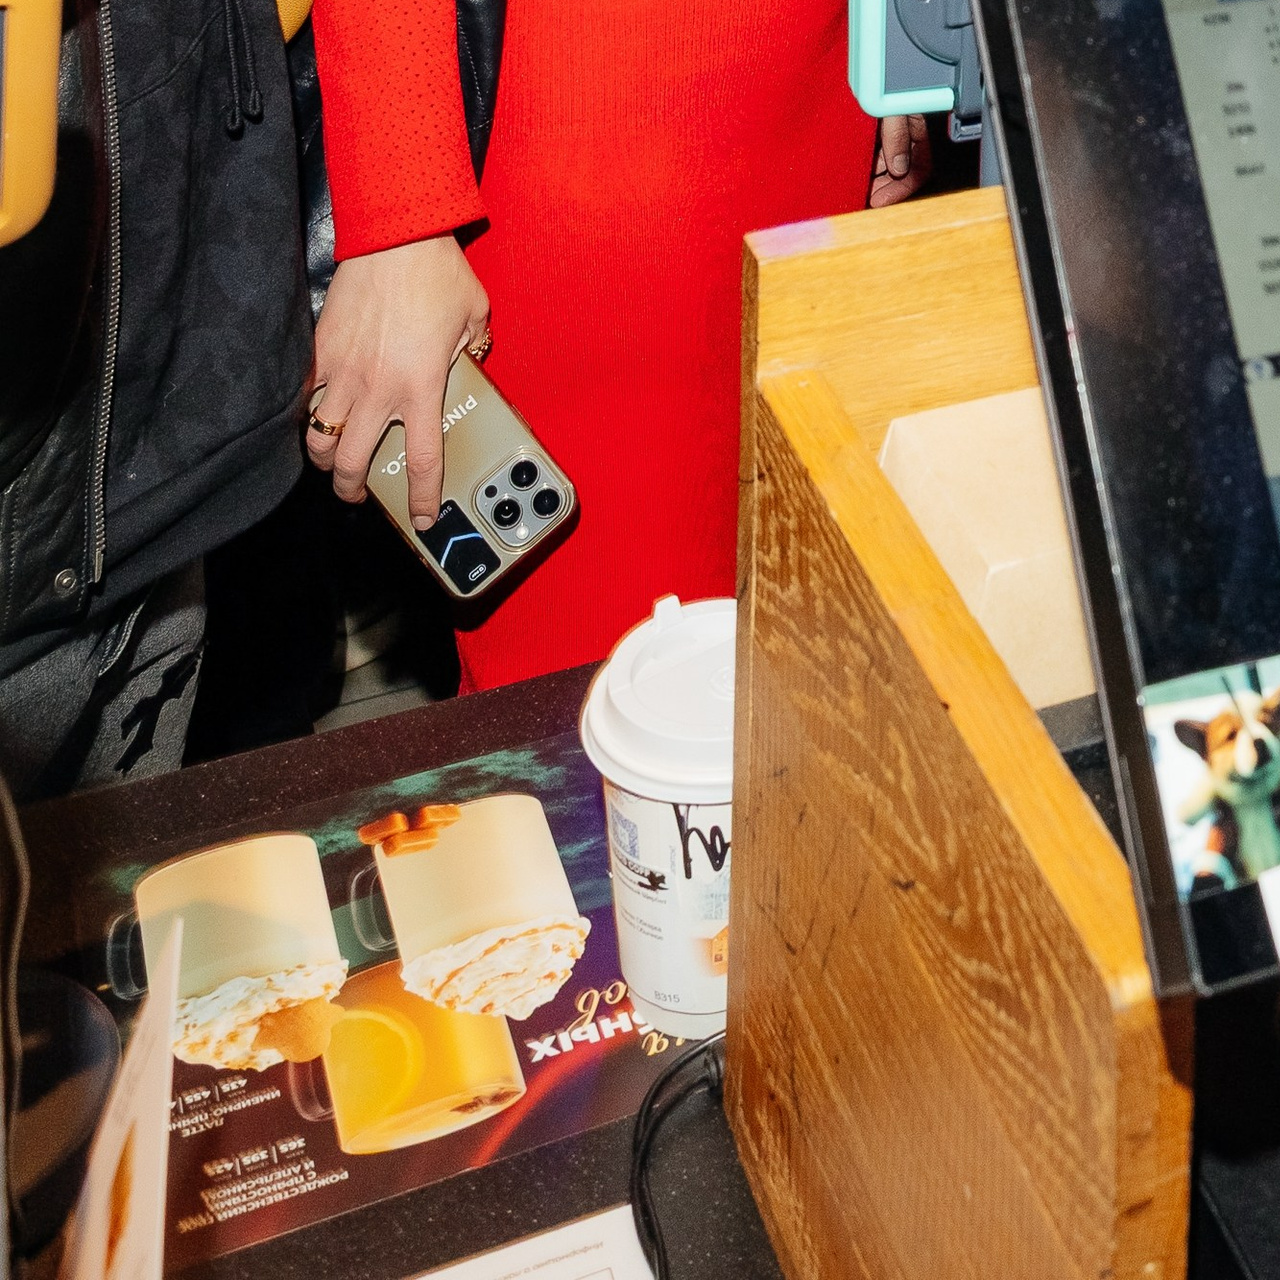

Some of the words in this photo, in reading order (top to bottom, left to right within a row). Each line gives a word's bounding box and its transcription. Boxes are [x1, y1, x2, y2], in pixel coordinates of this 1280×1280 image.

[181, 1117, 224, 1138] ЛАТТЕ
[279, 1137, 306, 1153] 365
[242, 1149, 269, 1166] 395
